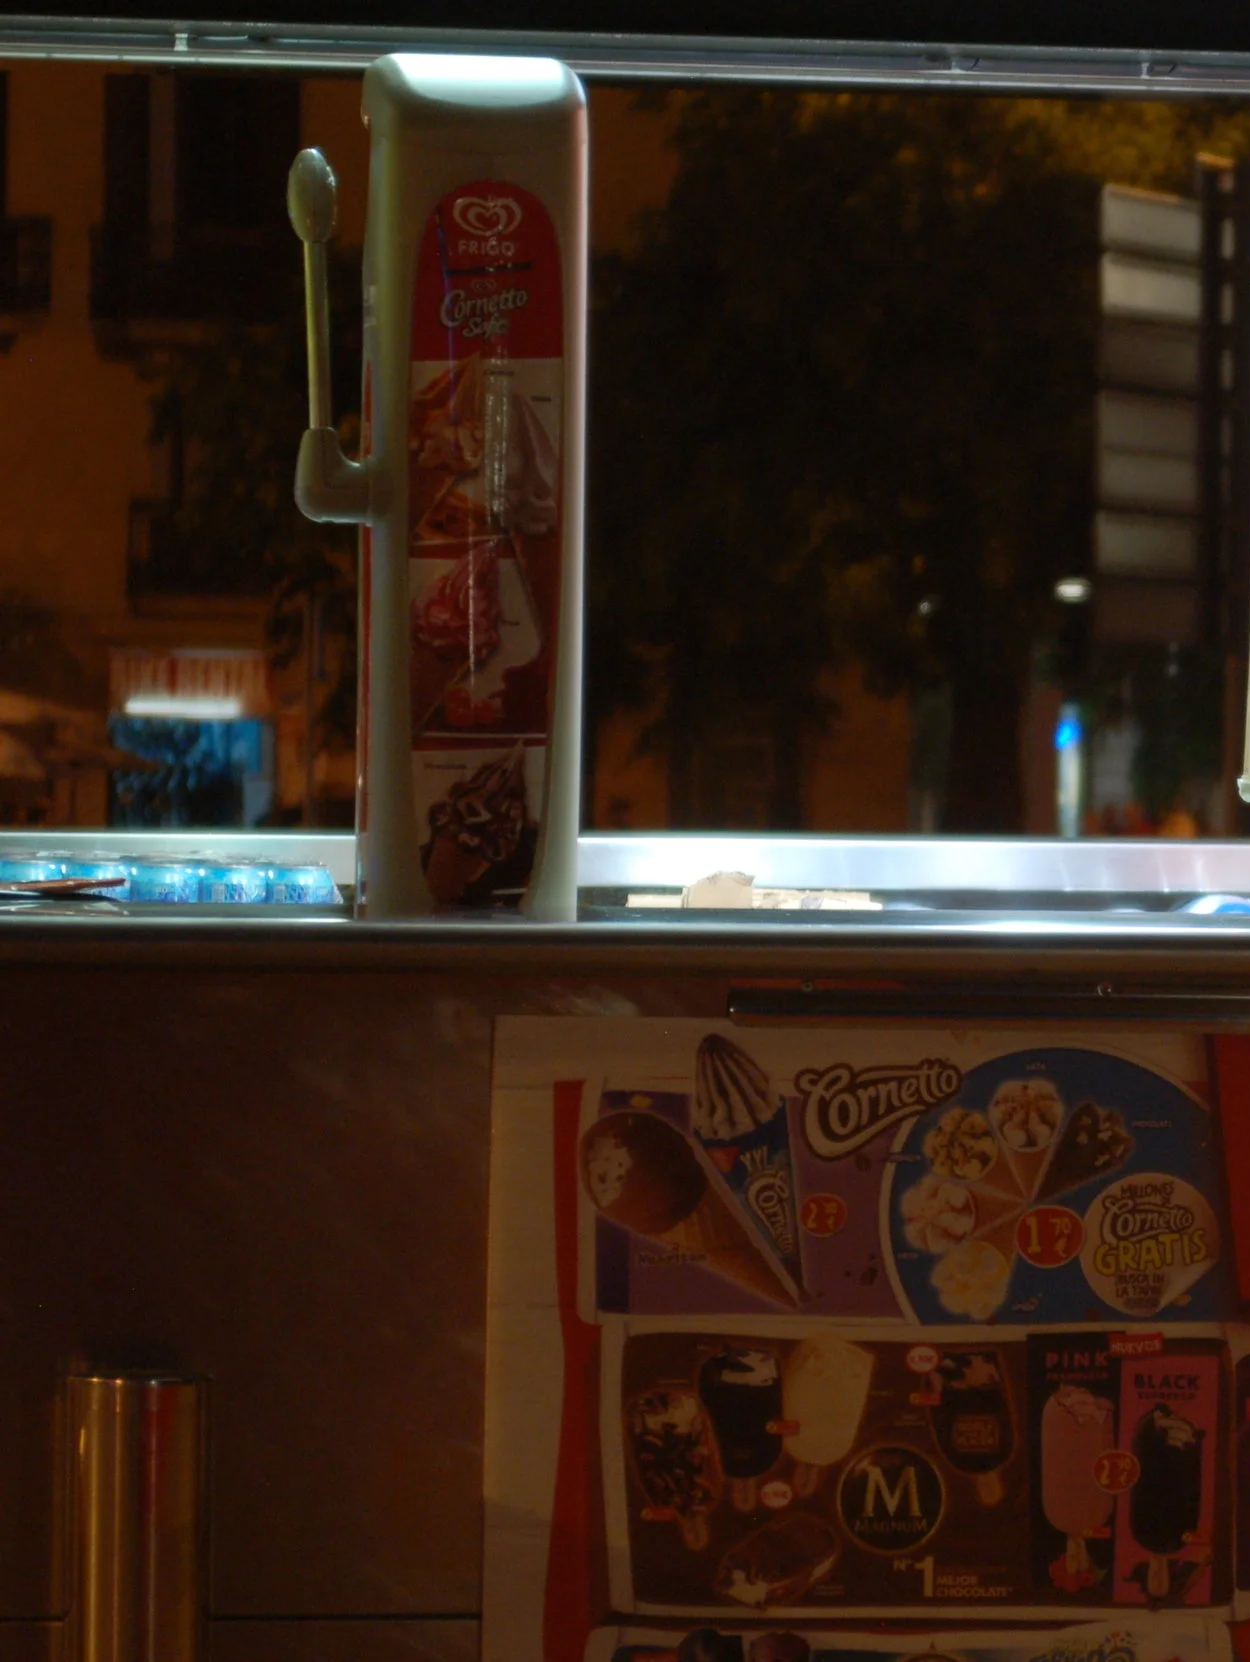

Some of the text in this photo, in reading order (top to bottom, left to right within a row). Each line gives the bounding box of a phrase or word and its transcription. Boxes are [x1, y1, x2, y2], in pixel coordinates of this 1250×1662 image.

[457, 238, 516, 257] FRIGO
[439, 288, 528, 328] Cornetto
[796, 1059, 961, 1161] Cornetto
[1120, 1181, 1176, 1199] MILLONES
[1102, 1195, 1195, 1247] Cornetto
[1094, 1228, 1208, 1276] GRATIS
[1045, 1349, 1109, 1369] PINK
[1134, 1373, 1201, 1391] BLACK
[854, 1518, 929, 1534] MAGNUM
[936, 1575, 979, 1588] MEJOR
